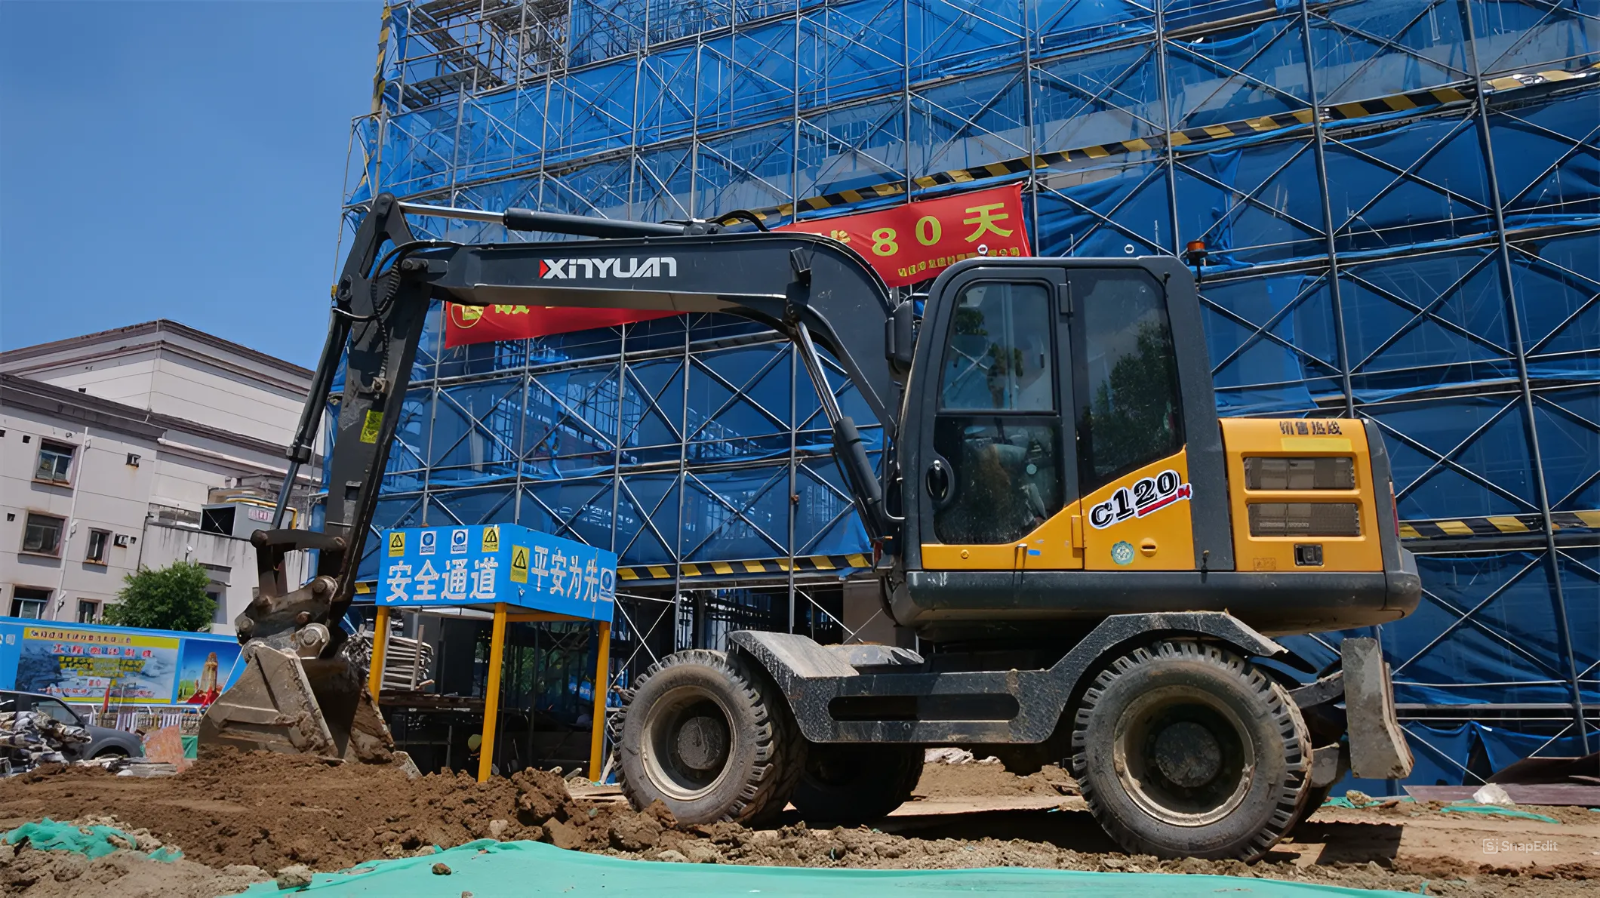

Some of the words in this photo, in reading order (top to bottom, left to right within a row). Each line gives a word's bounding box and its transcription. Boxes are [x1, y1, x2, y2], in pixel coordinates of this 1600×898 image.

[386, 557, 499, 602] 安全通道
[531, 545, 599, 602] 平安为先
